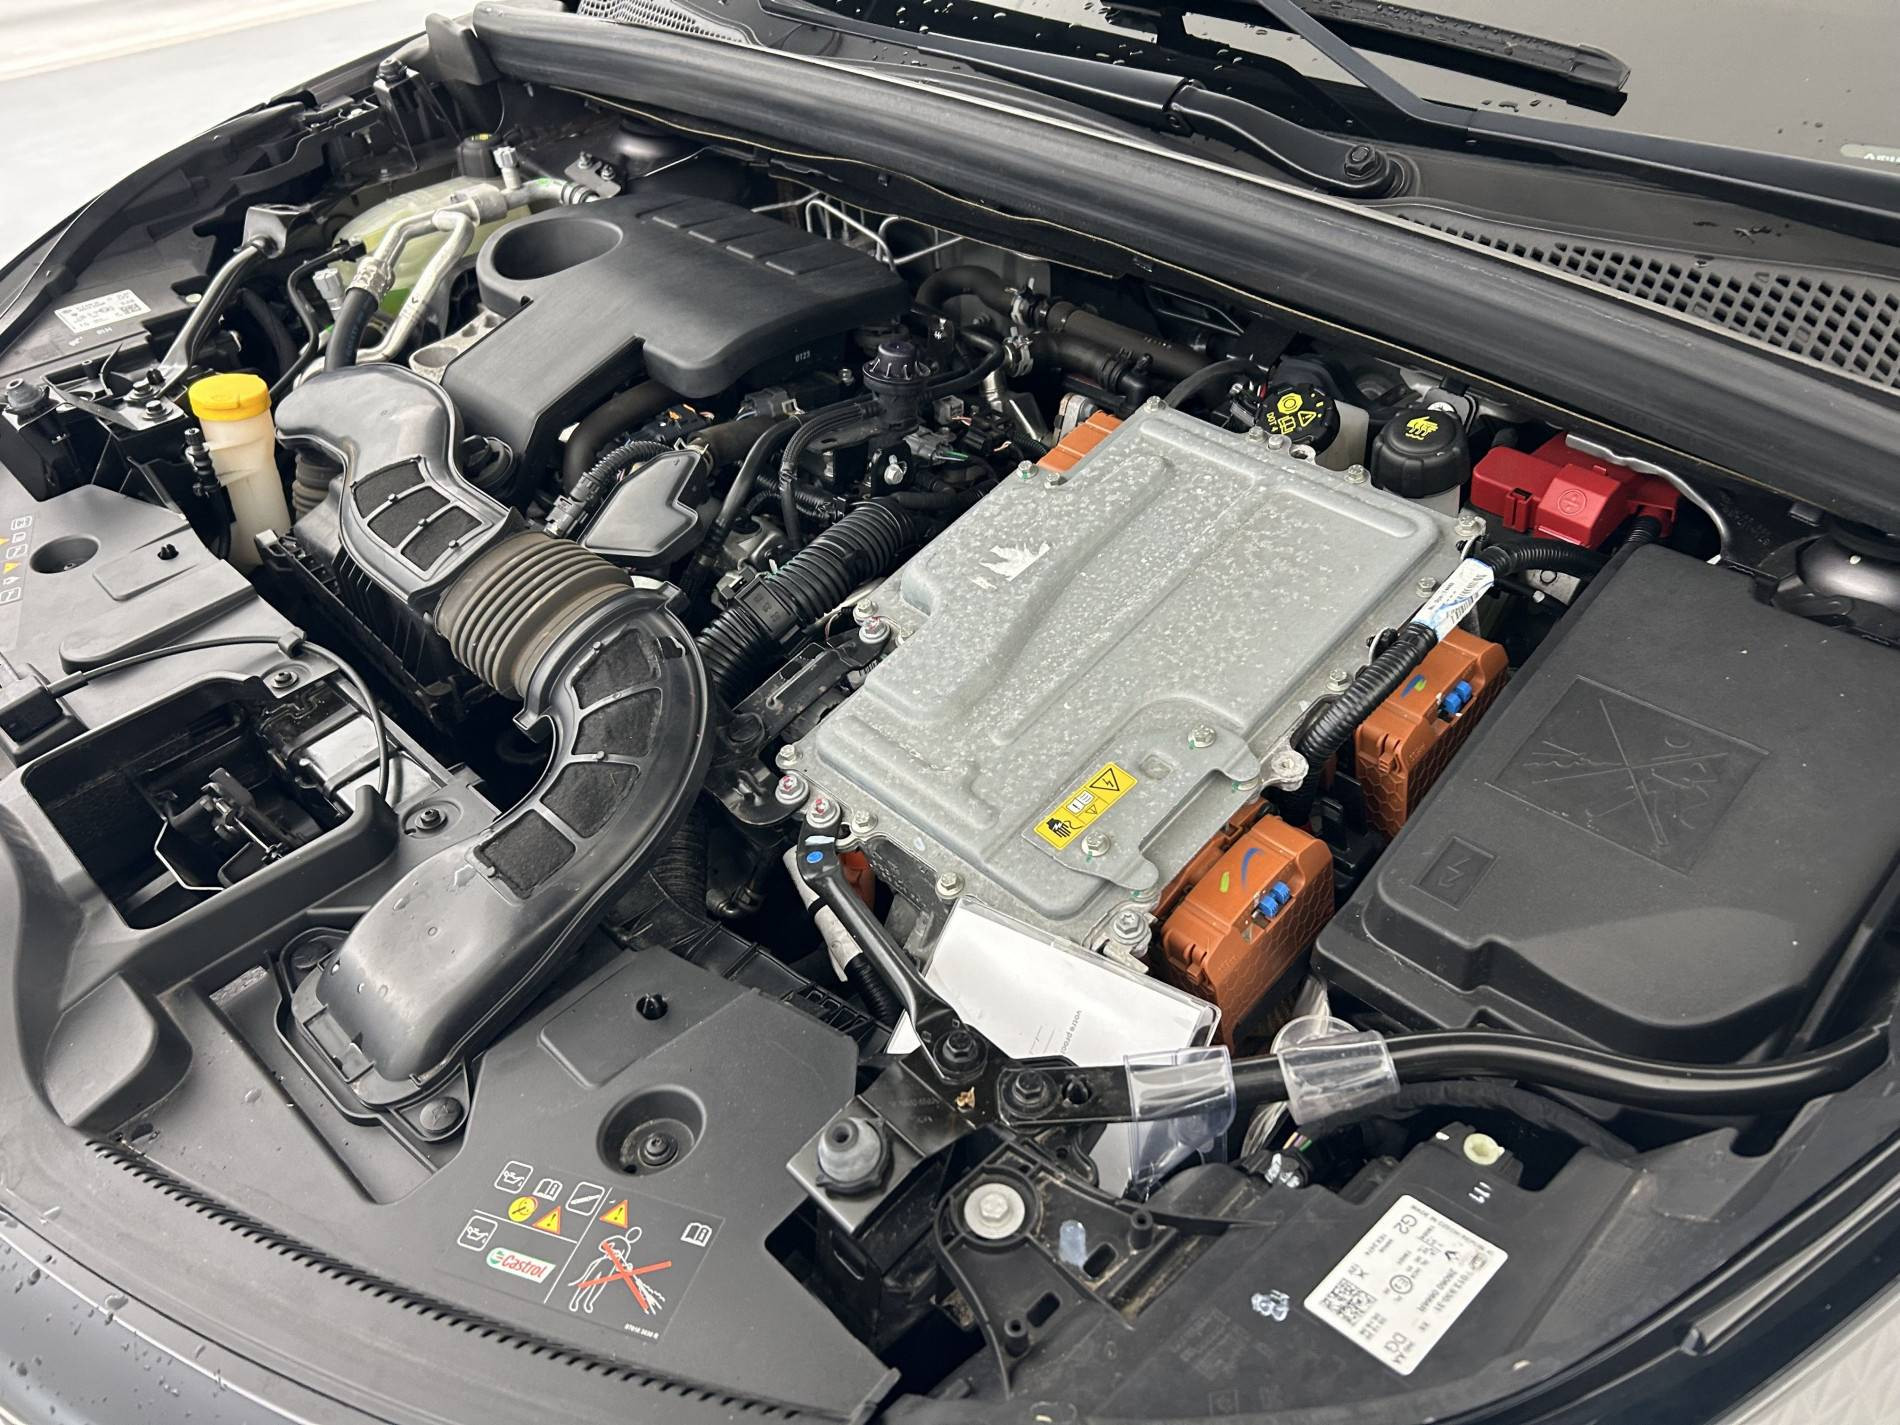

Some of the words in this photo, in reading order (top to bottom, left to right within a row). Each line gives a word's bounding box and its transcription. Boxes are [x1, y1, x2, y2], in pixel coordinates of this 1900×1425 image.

[1266, 412, 1277, 425] DOT
[1070, 1010, 1082, 1032] votre
[1394, 1214, 1417, 1234] G2
[501, 1254, 546, 1278] Castrol
[1384, 1332, 1407, 1353] DG
